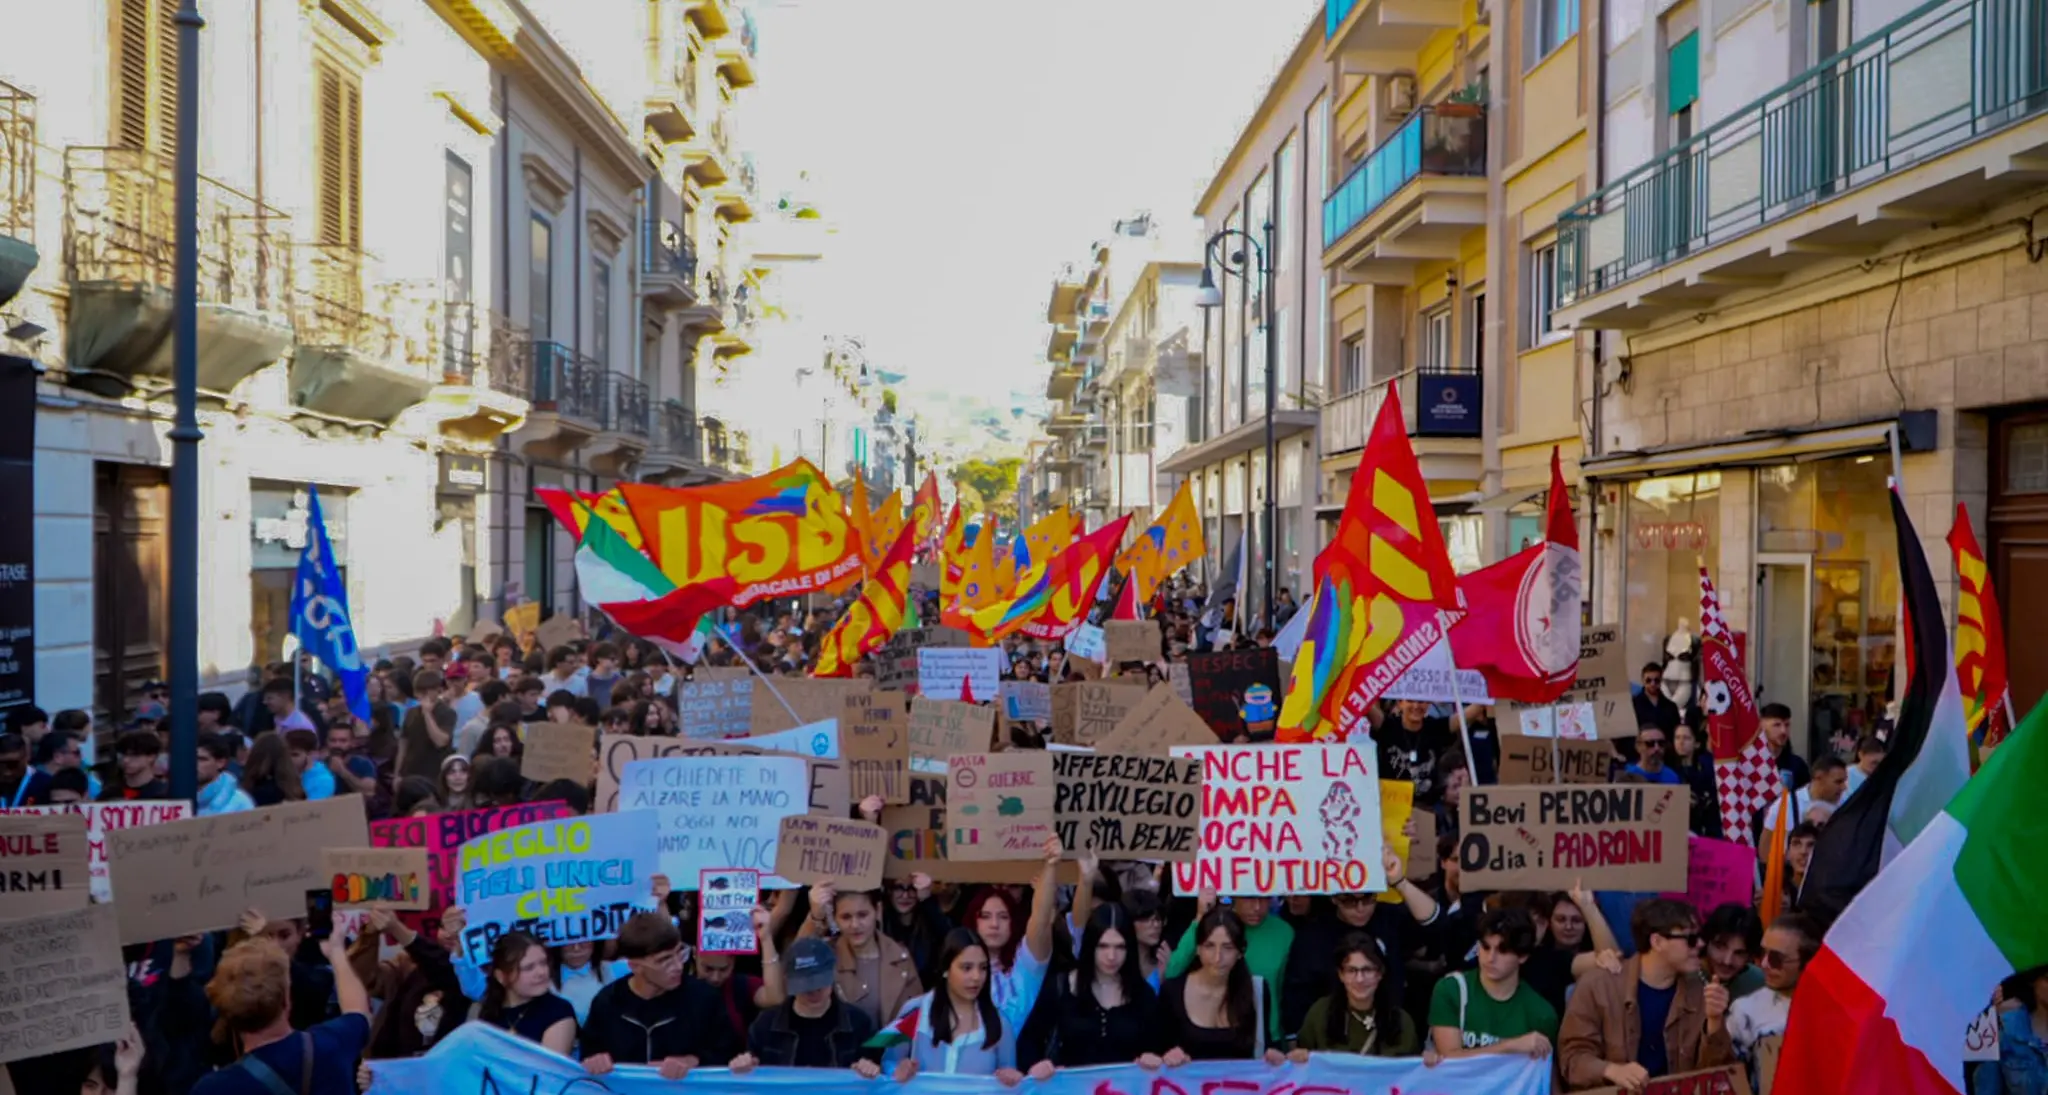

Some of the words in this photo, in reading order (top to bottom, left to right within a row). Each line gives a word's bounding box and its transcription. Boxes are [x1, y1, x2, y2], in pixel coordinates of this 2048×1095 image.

[659, 480, 847, 588] USB
[1710, 650, 1752, 712] REGGINA
[760, 768, 778, 784] DI
[1186, 749, 1303, 782] NCHE
[1321, 748, 1367, 777] LA
[713, 791, 730, 806] LA
[740, 790, 790, 808] MANO
[1054, 780, 1195, 818] PRIVILEGIO
[1201, 784, 1297, 817] IMPA
[1468, 792, 1526, 826] Bevi
[1539, 788, 1643, 826] PERONI
[727, 814, 759, 829] NOI
[1129, 822, 1195, 851] BENE
[1199, 820, 1303, 853] OGNA
[462, 821, 591, 873] MEGLIO
[657, 836, 690, 849] IAMO
[697, 837, 716, 850] LA
[722, 838, 776, 870] VOC
[1459, 832, 1527, 873] Odia
[1537, 848, 1544, 868] i
[1552, 830, 1662, 869] PADRONI
[545, 859, 635, 890] UNICI
[1176, 856, 1222, 892] UN
[1231, 857, 1368, 893] FUTURO
[516, 888, 587, 920] CHE
